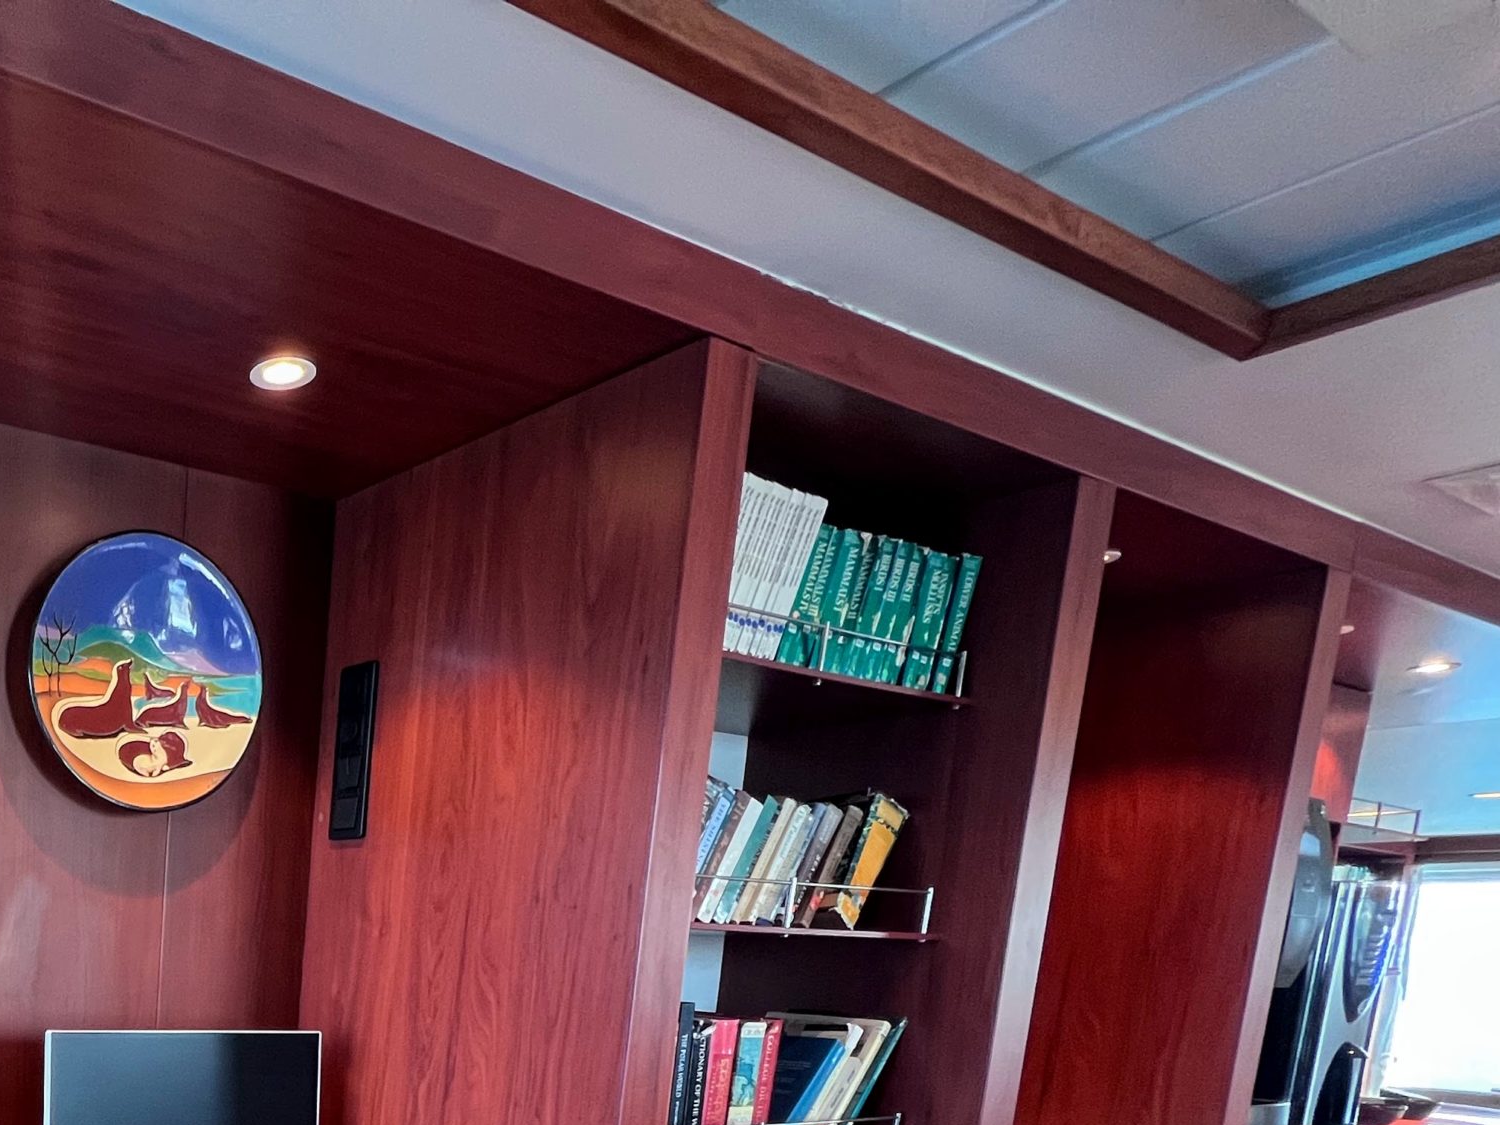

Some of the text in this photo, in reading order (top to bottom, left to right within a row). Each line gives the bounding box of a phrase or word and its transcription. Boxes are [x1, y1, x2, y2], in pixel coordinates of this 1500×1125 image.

[802, 541, 828, 600] MAMMALS
[807, 546, 836, 617] MAMMALS III
[835, 546, 860, 606] MAMMALS
[851, 551, 875, 610] MAMMALS
[876, 554, 892, 586] BIRDS
[890, 558, 906, 590] BIRDS
[904, 561, 920, 593] BIRDS
[947, 571, 975, 652] LOWER ANIMAL
[680, 1033, 689, 1048] THE
[677, 1049, 687, 1073] POLAR
[695, 1036, 707, 1083] CTIONARY
[675, 1073, 684, 1098] WORLD
[694, 1084, 702, 1097] OF
[691, 1099, 700, 1117] THE
